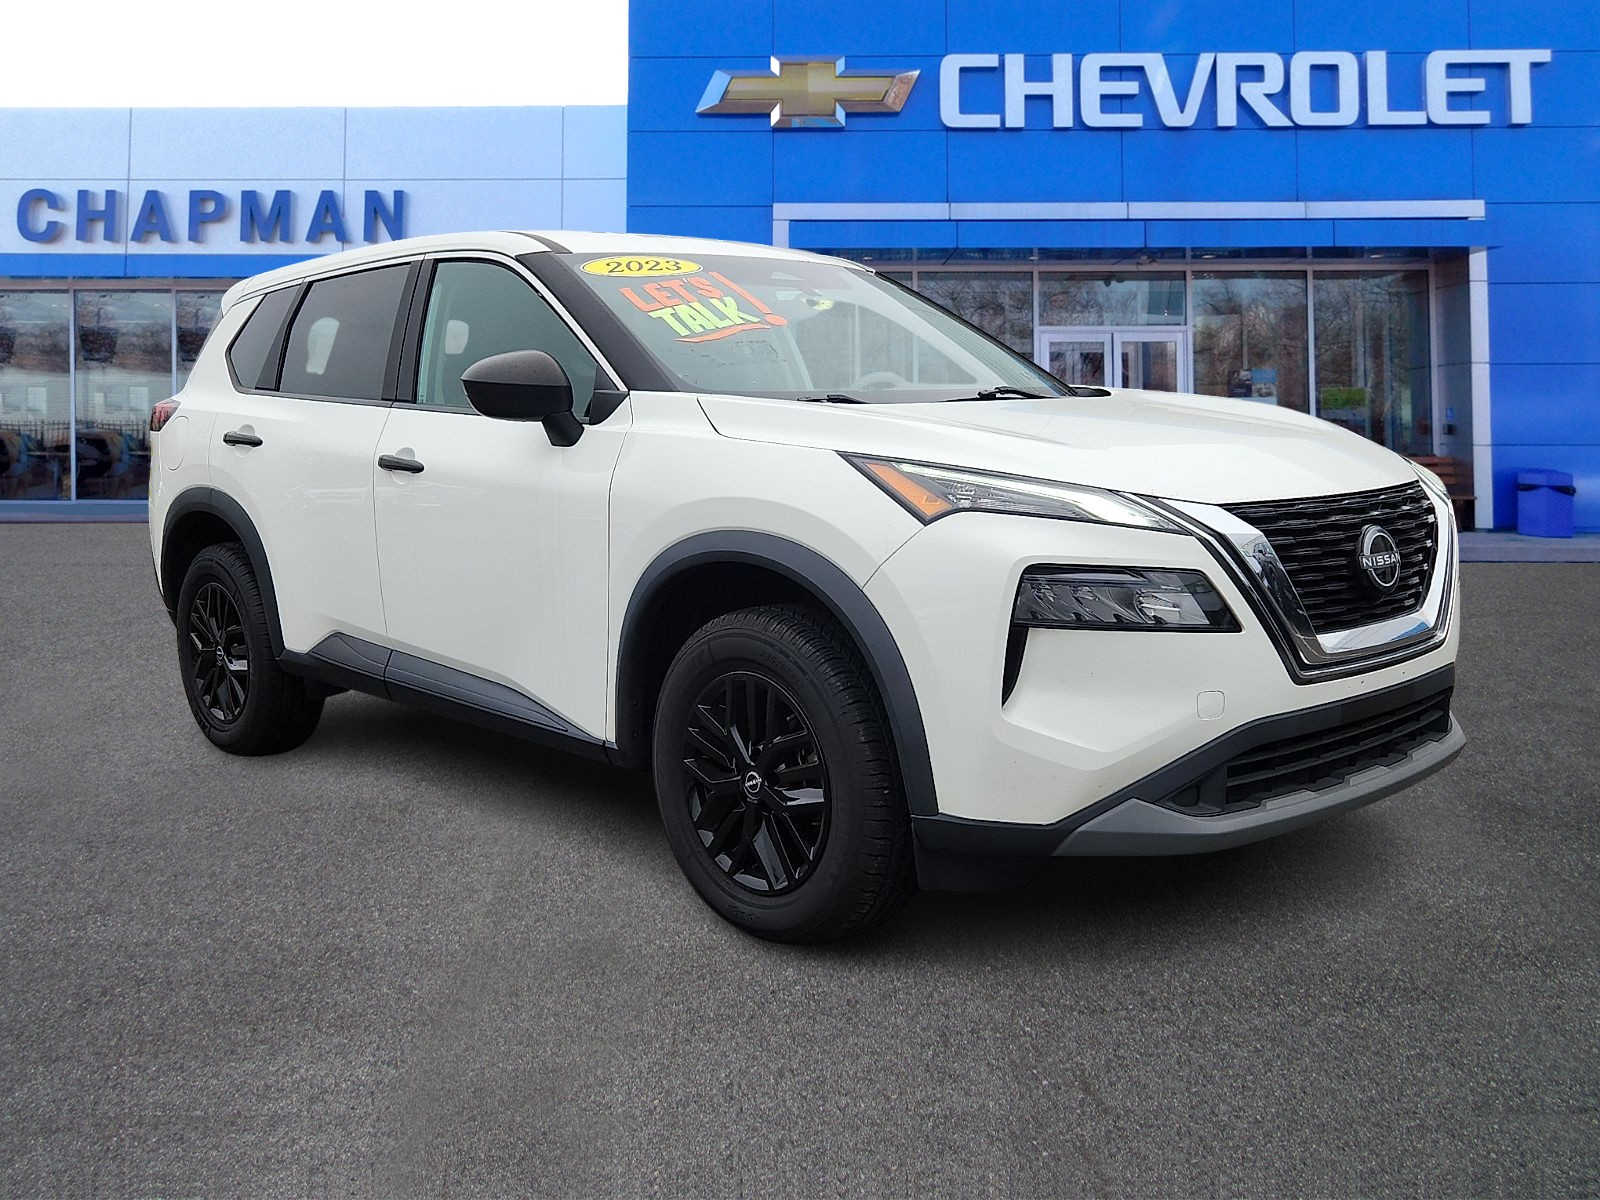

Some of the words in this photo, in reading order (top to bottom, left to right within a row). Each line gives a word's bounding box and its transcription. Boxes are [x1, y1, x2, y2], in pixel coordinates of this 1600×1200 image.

[938, 48, 1553, 129] CHEVROLET
[17, 189, 405, 243] CHAPMAN
[606, 259, 683, 274] 2023
[619, 276, 725, 312] LET'S
[1362, 553, 1401, 567] NISSAN
